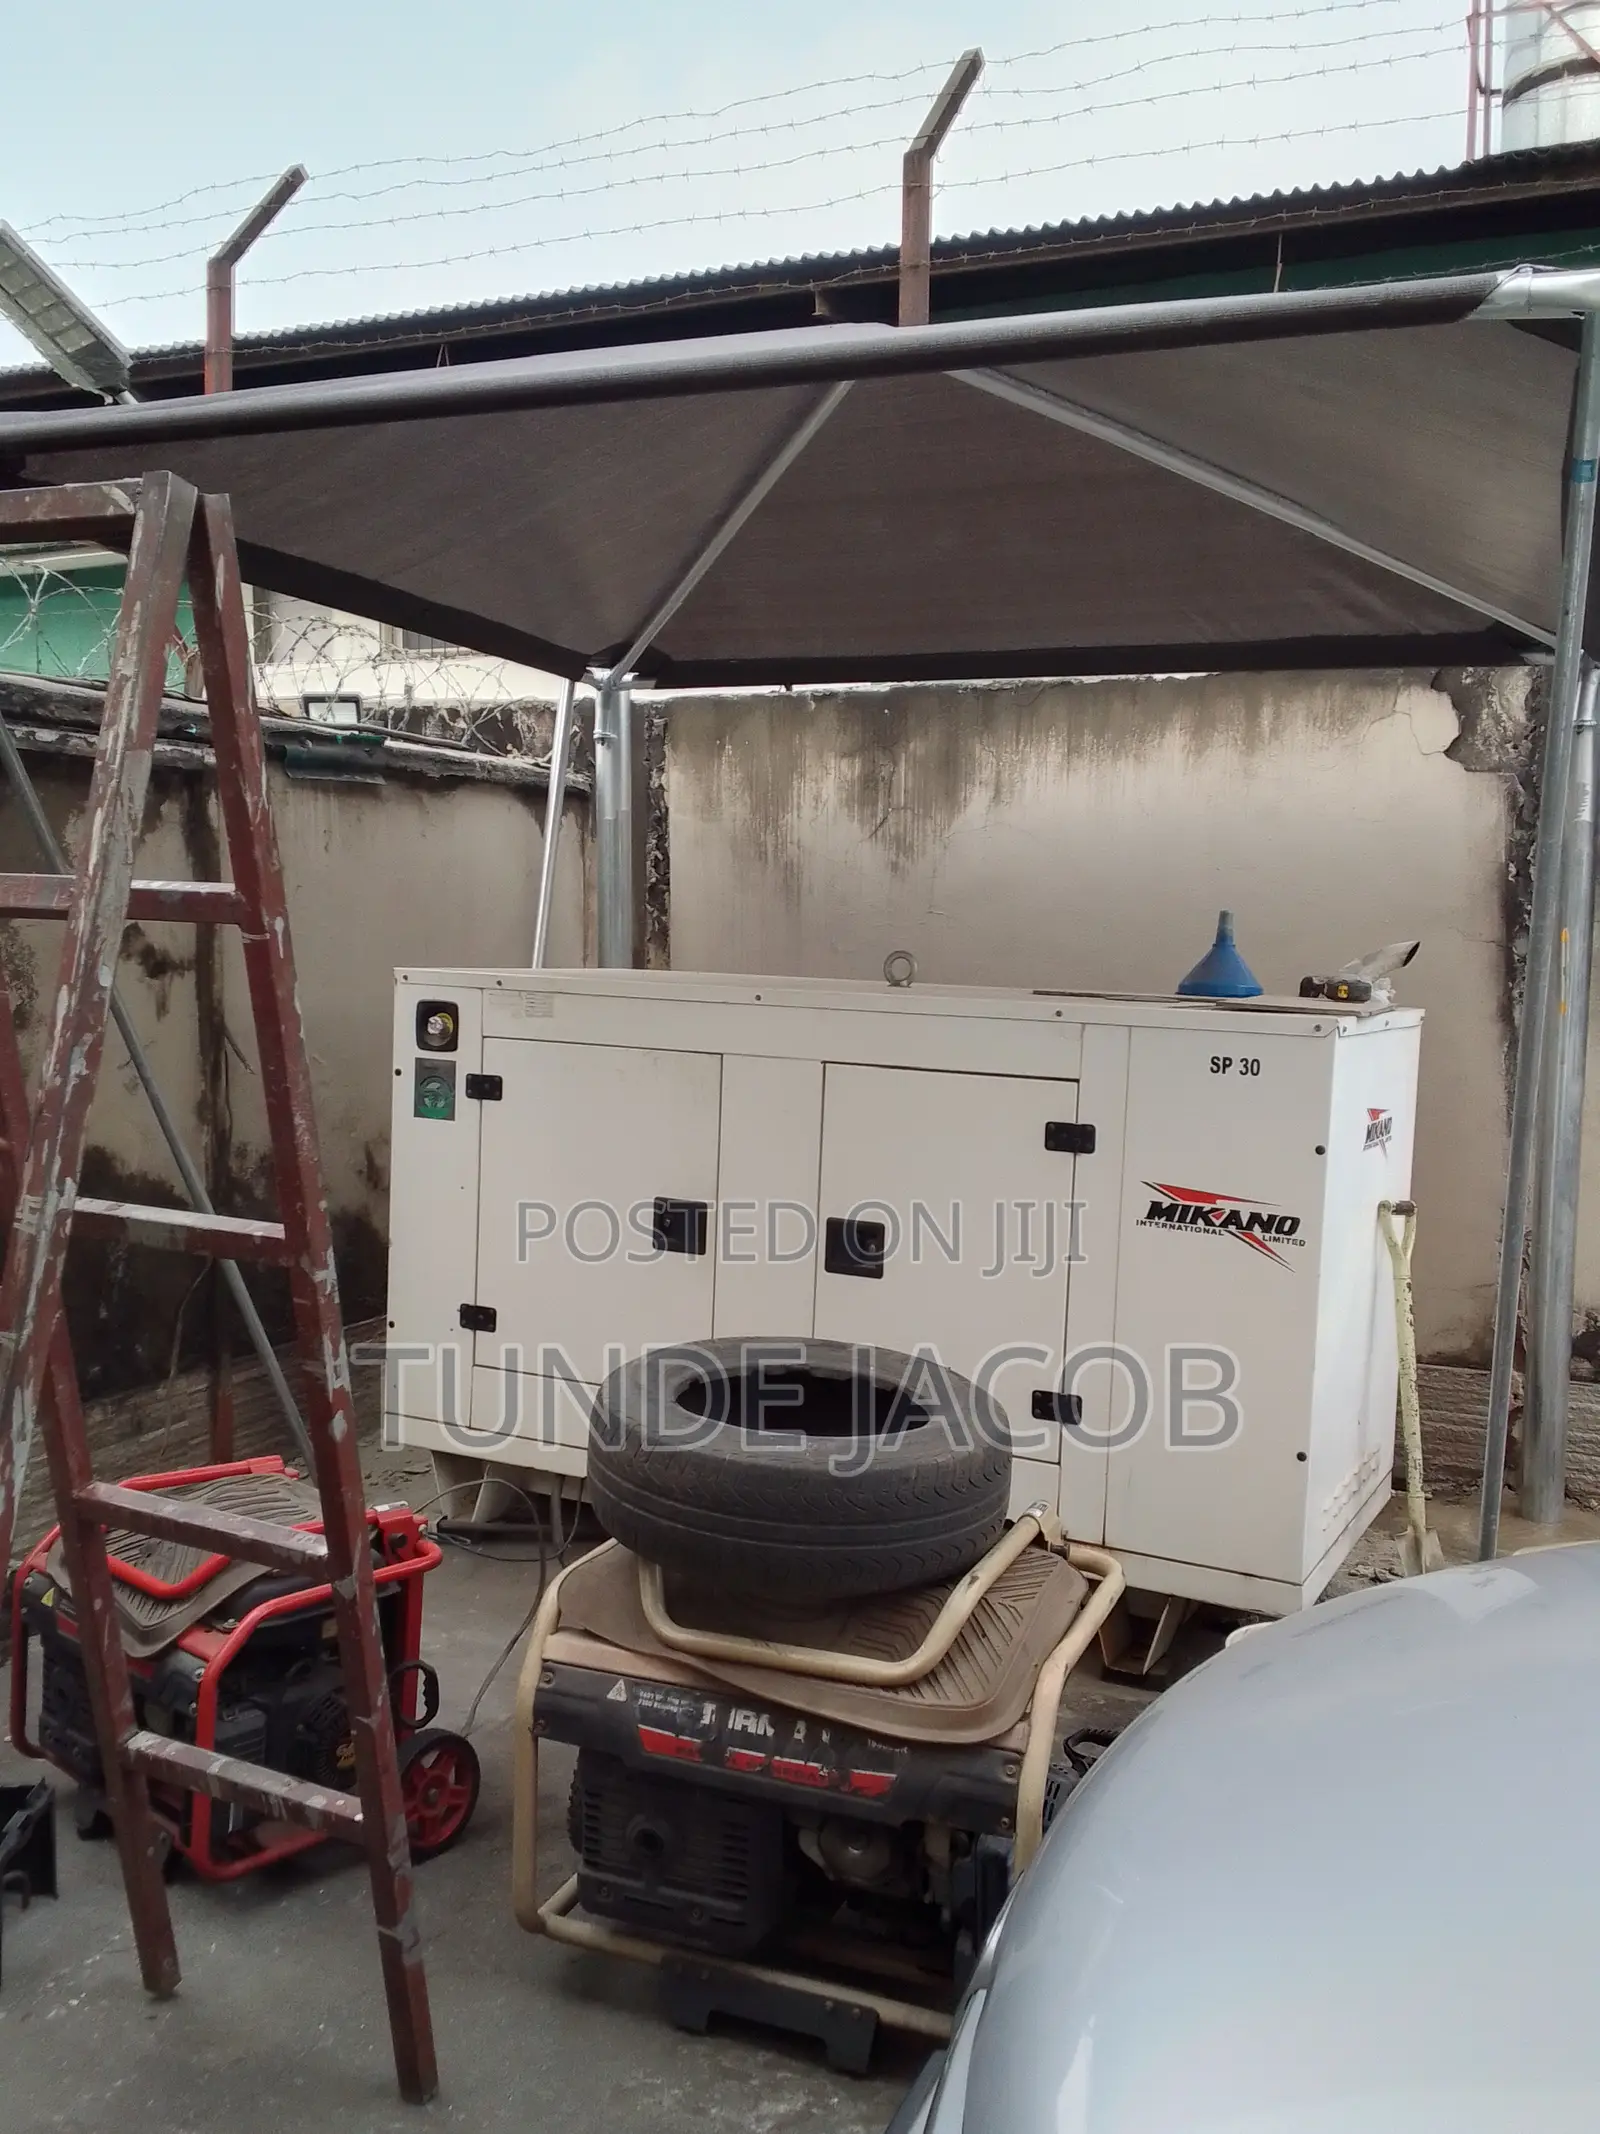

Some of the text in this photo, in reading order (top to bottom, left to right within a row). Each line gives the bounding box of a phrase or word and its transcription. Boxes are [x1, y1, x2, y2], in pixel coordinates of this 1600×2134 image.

[1210, 1056, 1261, 1076] SP 30
[1364, 1117, 1393, 1145] MIKANO
[1136, 1219, 1225, 1236] INTERNATIONAL
[1144, 1200, 1301, 1236] MIKANO
[1262, 1234, 1306, 1247] LIMITED
